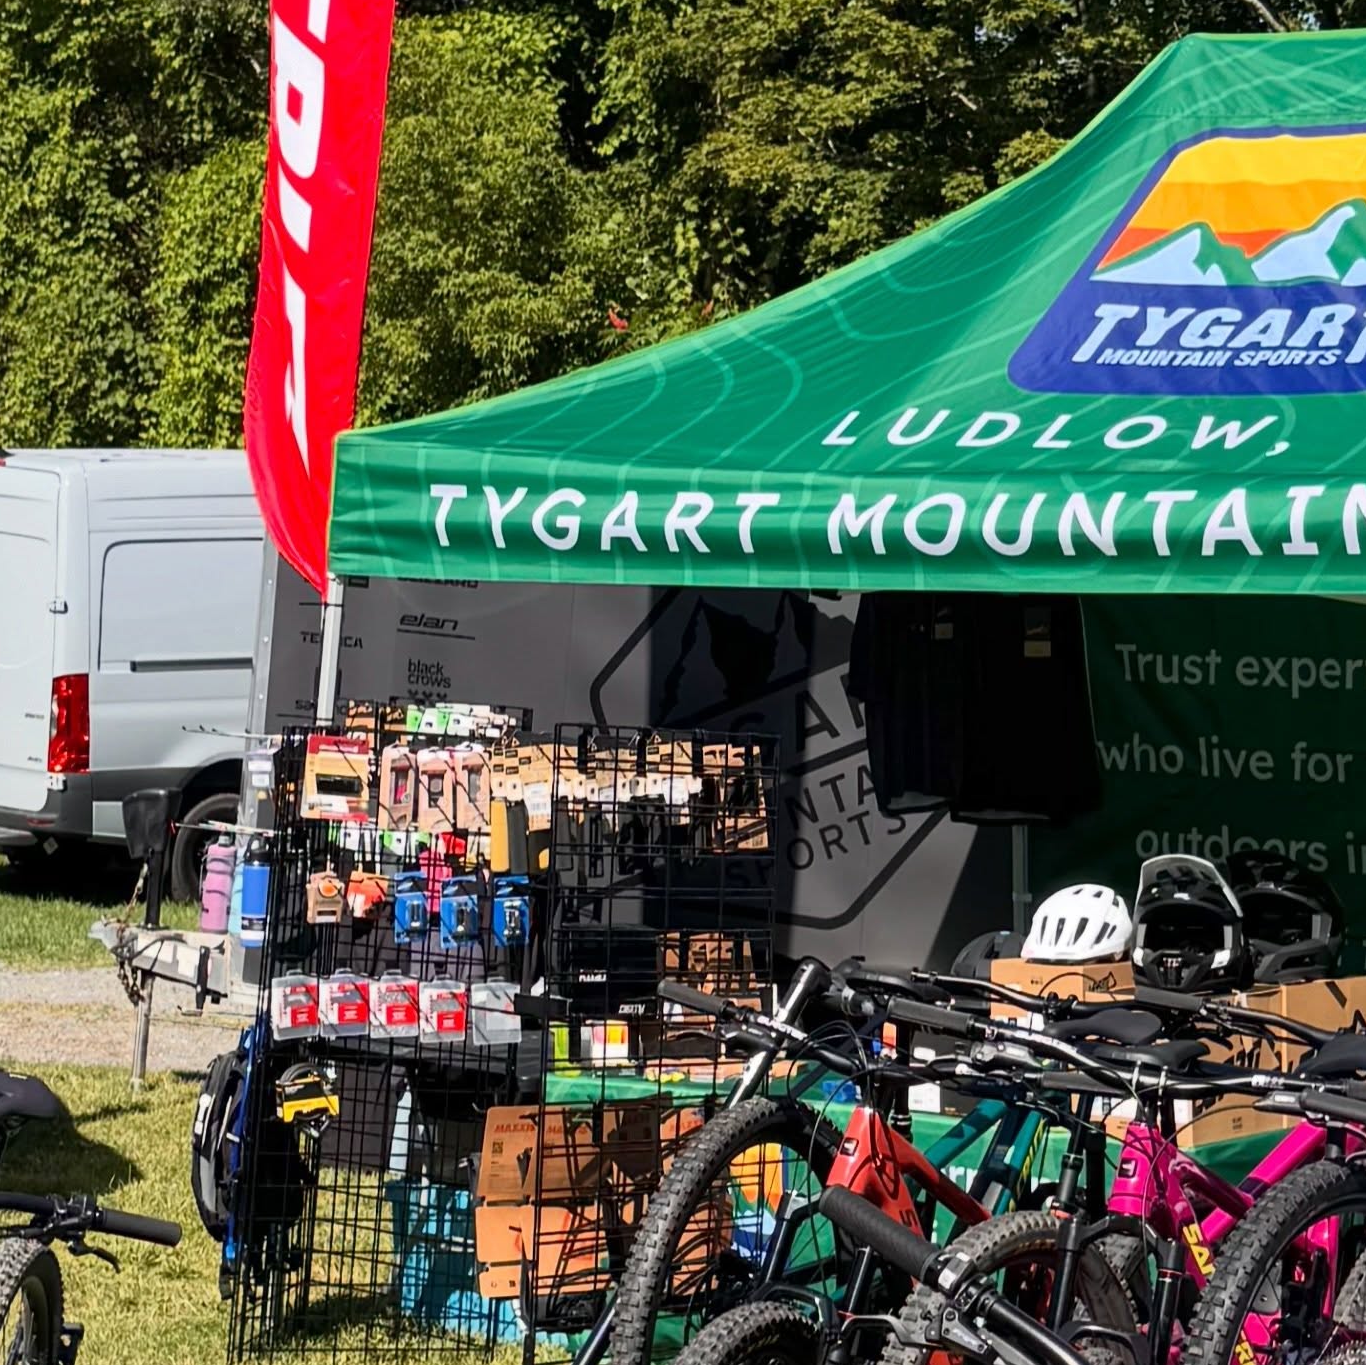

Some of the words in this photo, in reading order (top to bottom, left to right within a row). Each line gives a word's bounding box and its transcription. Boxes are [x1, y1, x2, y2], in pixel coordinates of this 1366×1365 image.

[1096, 348, 1233, 368] MOUNTAIN
[1234, 347, 1344, 367] SPORTS
[823, 408, 1292, 457] LUDLOW,
[430, 483, 779, 556] TYGART
[399, 613, 459, 631] elan
[408, 659, 444, 675] black
[408, 672, 452, 689] crows
[1114, 643, 1222, 686] Trust
[1097, 732, 1184, 775] who
[1199, 734, 1275, 781] live
[1291, 741, 1353, 783] for
